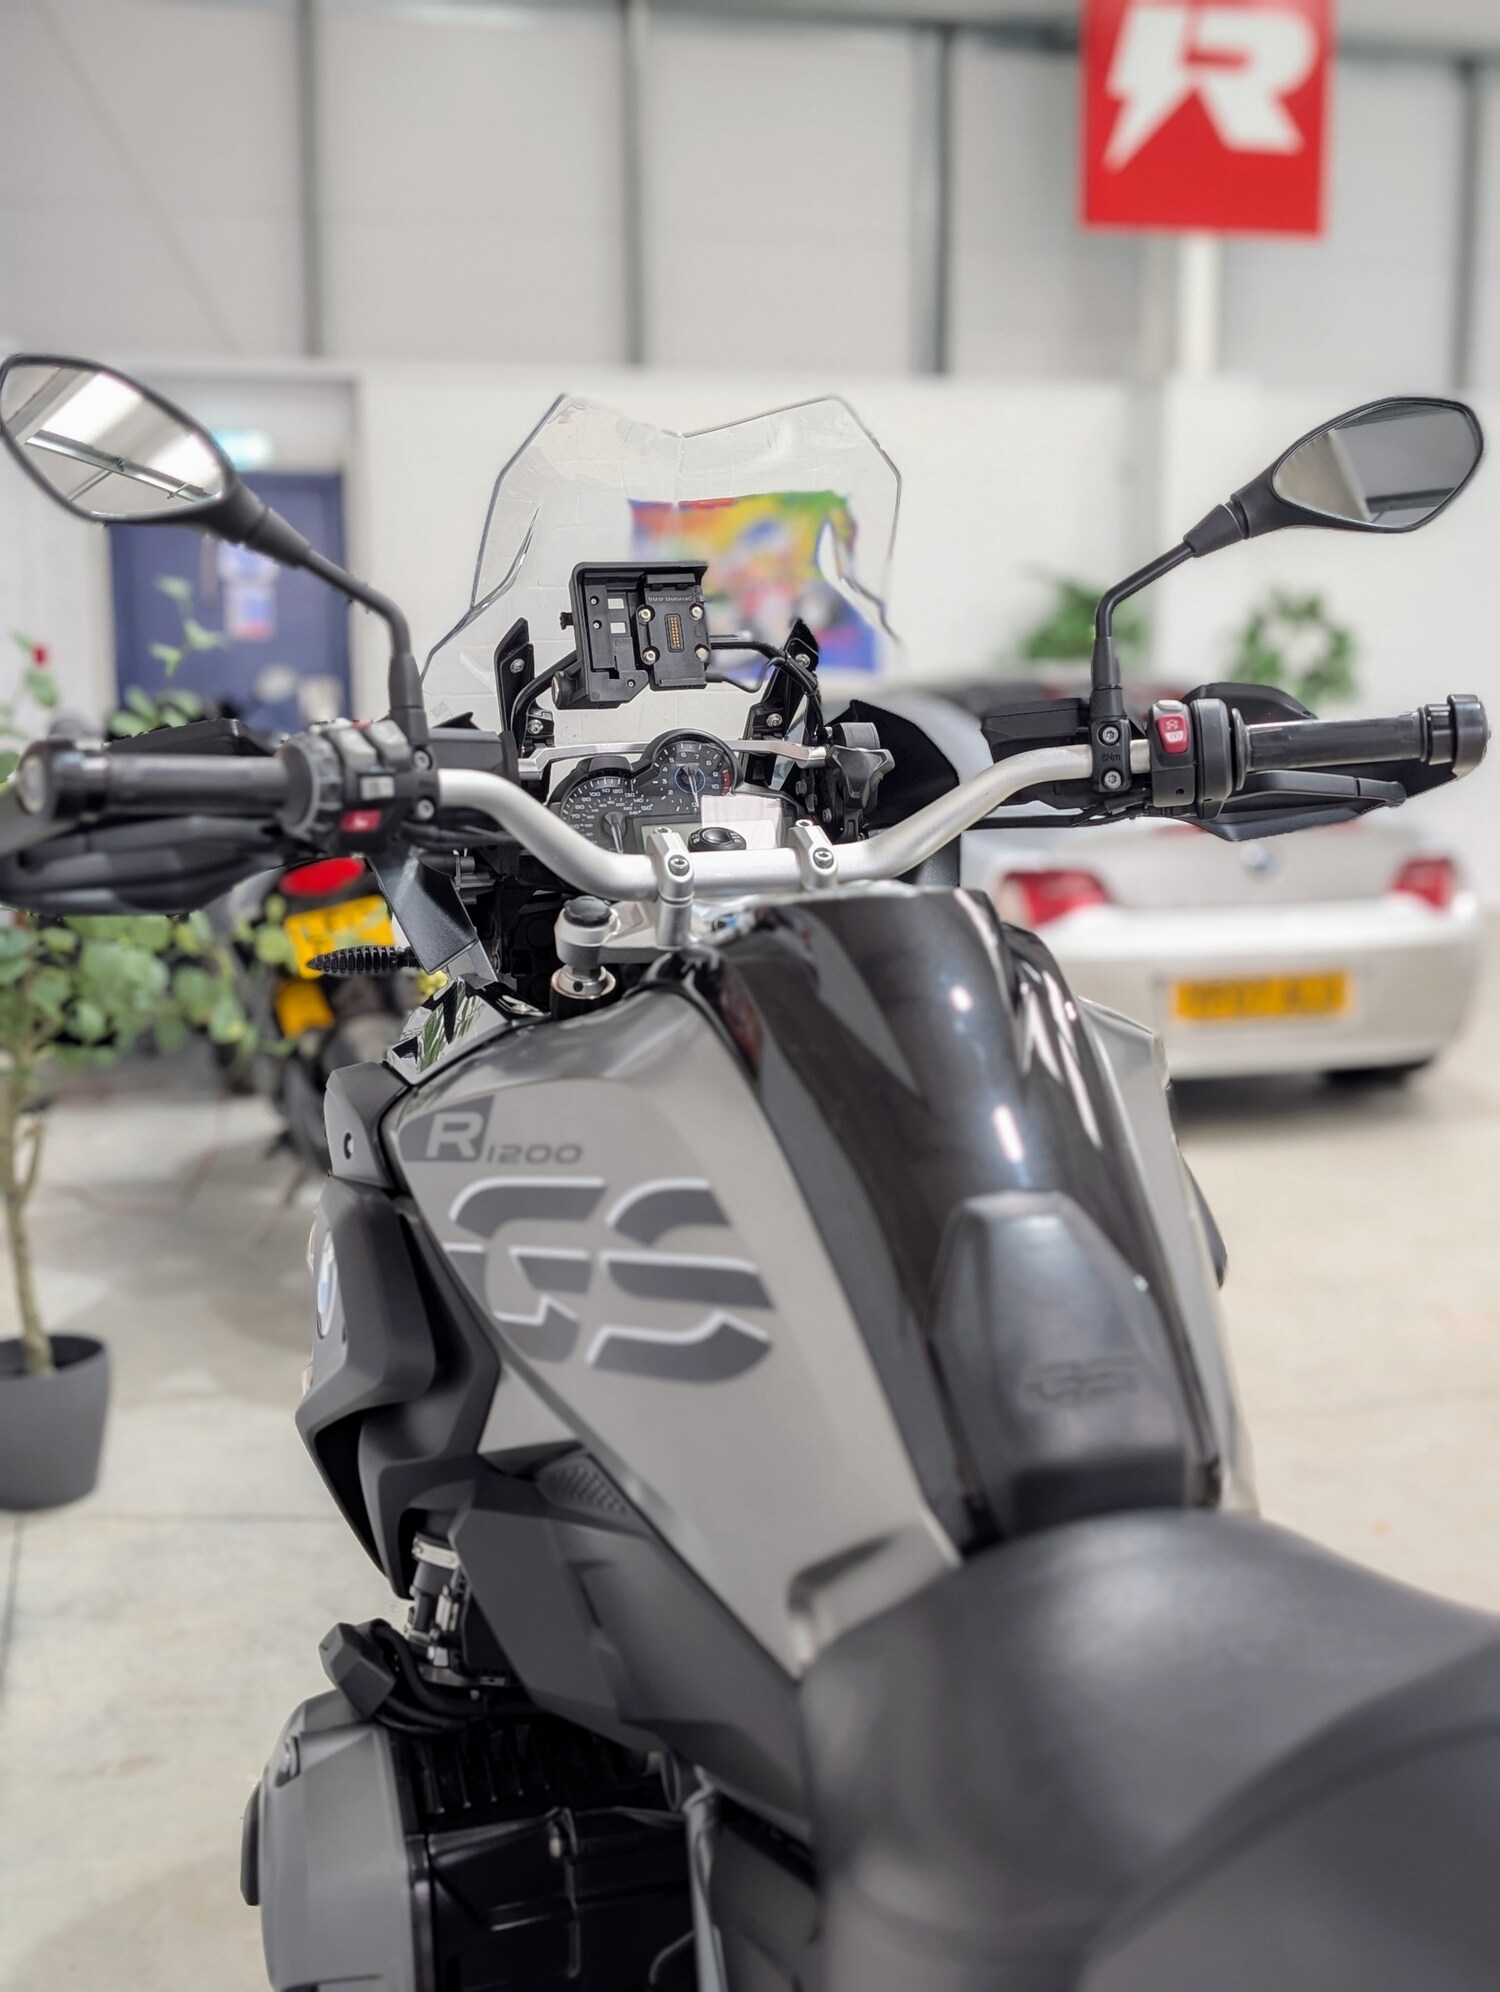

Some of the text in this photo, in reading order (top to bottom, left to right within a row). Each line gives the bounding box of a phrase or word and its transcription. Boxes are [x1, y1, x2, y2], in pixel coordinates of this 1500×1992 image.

[425, 1111, 583, 1165] R 1200
[442, 1175, 777, 1387] GS
